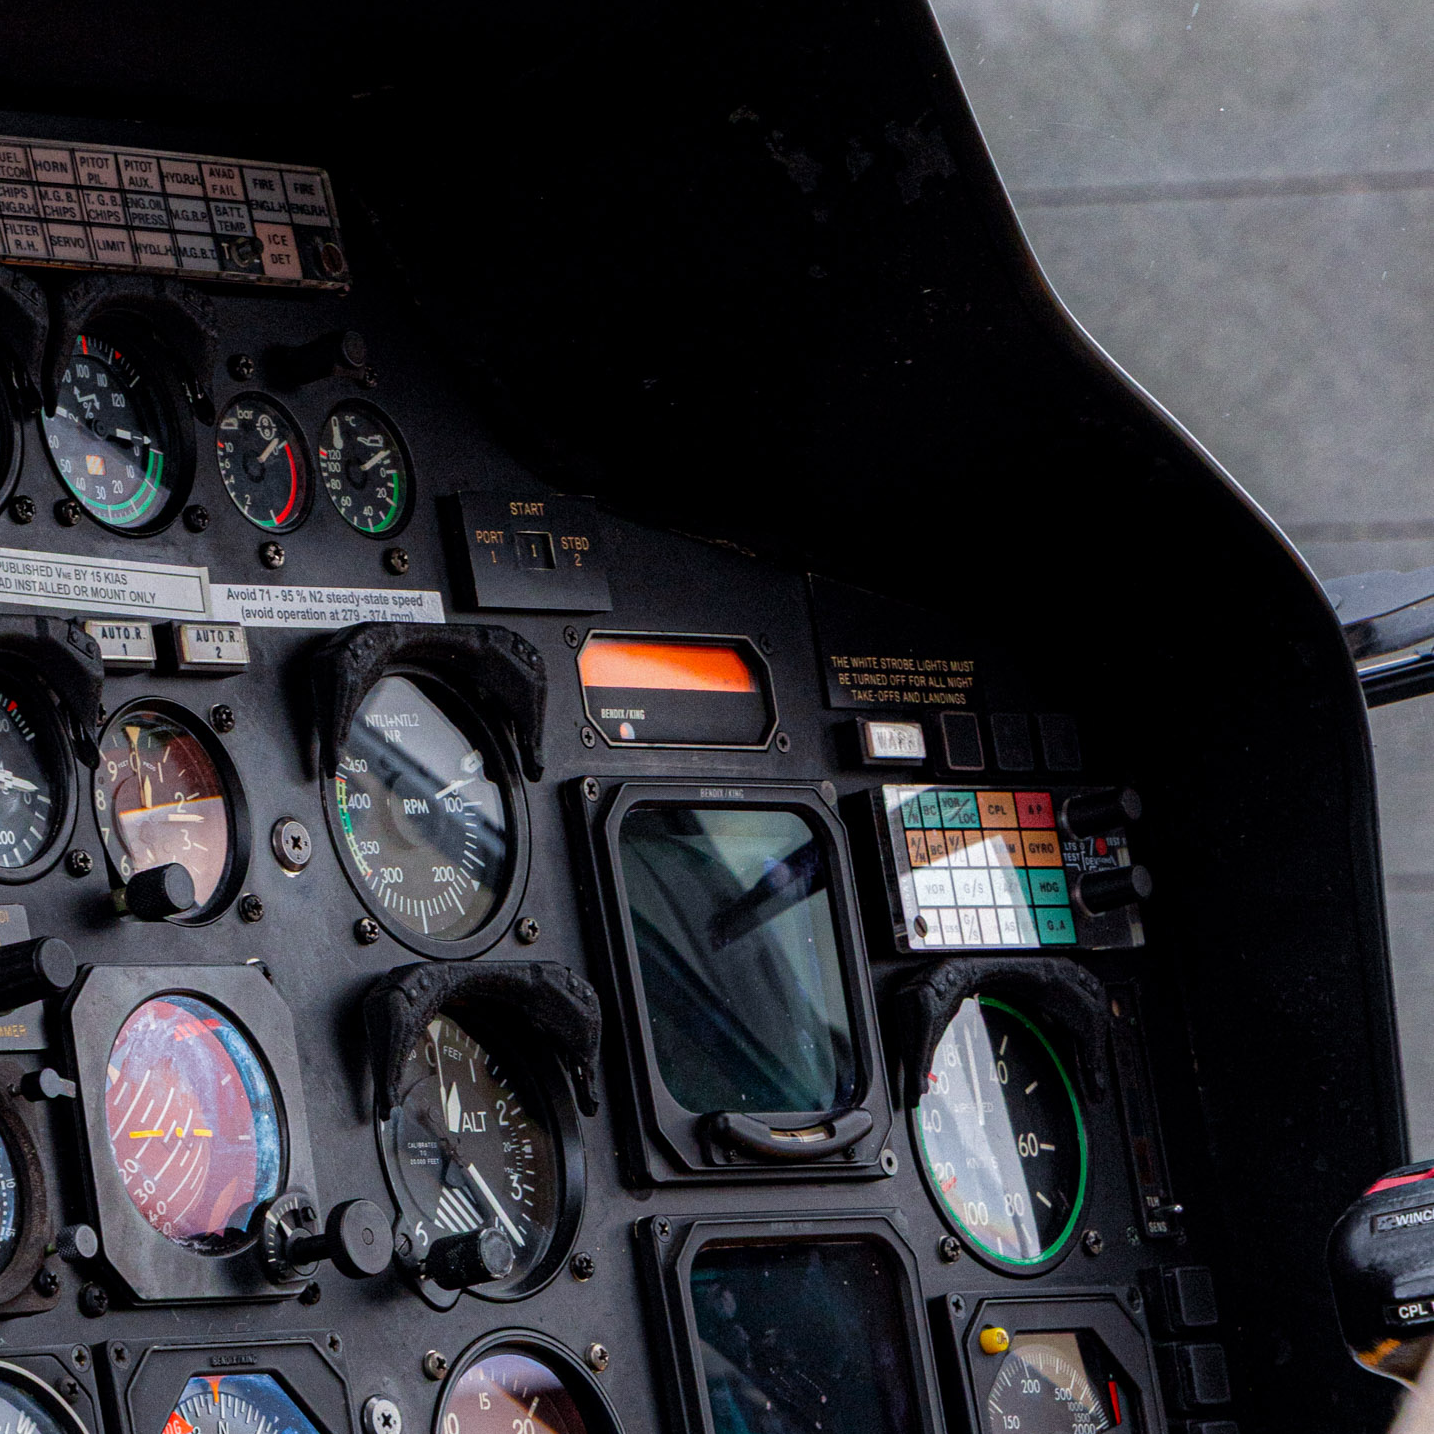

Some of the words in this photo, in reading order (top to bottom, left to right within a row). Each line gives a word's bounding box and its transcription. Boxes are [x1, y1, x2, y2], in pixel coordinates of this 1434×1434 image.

[79, 156, 109, 169] PITOT
[124, 159, 152, 172] PITOT
[129, 177, 154, 189] AUX.
[51, 235, 85, 249] SERVO
[95, 238, 126, 252] LIMIT
[268, 234, 288, 246] ICE
[271, 253, 291, 265] DET
[510, 502, 544, 516] START
[475, 530, 504, 543] PORT
[561, 536, 589, 550] STBD
[74, 569, 87, 580] BY
[91, 572, 102, 583] 15
[104, 573, 128, 586] KIAS
[15, 579, 71, 595] INSTALLED
[73, 585, 89, 597] OR
[91, 587, 126, 601] MOUNT
[129, 591, 156, 604] ONLY
[227, 588, 257, 601] Avoid
[281, 590, 294, 602] 95
[310, 591, 324, 603] N2
[326, 592, 389, 607] steady-state
[392, 594, 423, 607] speed
[241, 606, 274, 621] (avoid
[277, 608, 326, 622] operation
[330, 609, 340, 620] at
[341, 609, 360, 622] 279
[831, 656, 850, 668] THE
[850, 657, 878, 668] WHITE
[880, 658, 915, 670] STROBE
[916, 660, 948, 671] LIGHTS
[950, 661, 974, 672] MUST
[838, 673, 851, 685] BE
[852, 674, 887, 686] TURNED
[890, 675, 906, 686] OFF
[909, 676, 926, 687] FOR
[928, 677, 946, 688] ALL
[947, 677, 973, 688] NIGHT
[851, 689, 901, 702] TAKE-OFFS
[903, 692, 921, 703] AND
[922, 692, 966, 704] LANDINGS
[601, 708, 645, 721] BENDIX/KING
[403, 799, 430, 815] RPM
[988, 805, 1007, 815] CPL
[1029, 842, 1054, 853] GYRO
[1039, 882, 1059, 893] HDG
[1396, 1208, 1434, 1226] WINC
[1398, 1303, 1429, 1319] CPL
[1021, 1379, 1041, 1395] 200
